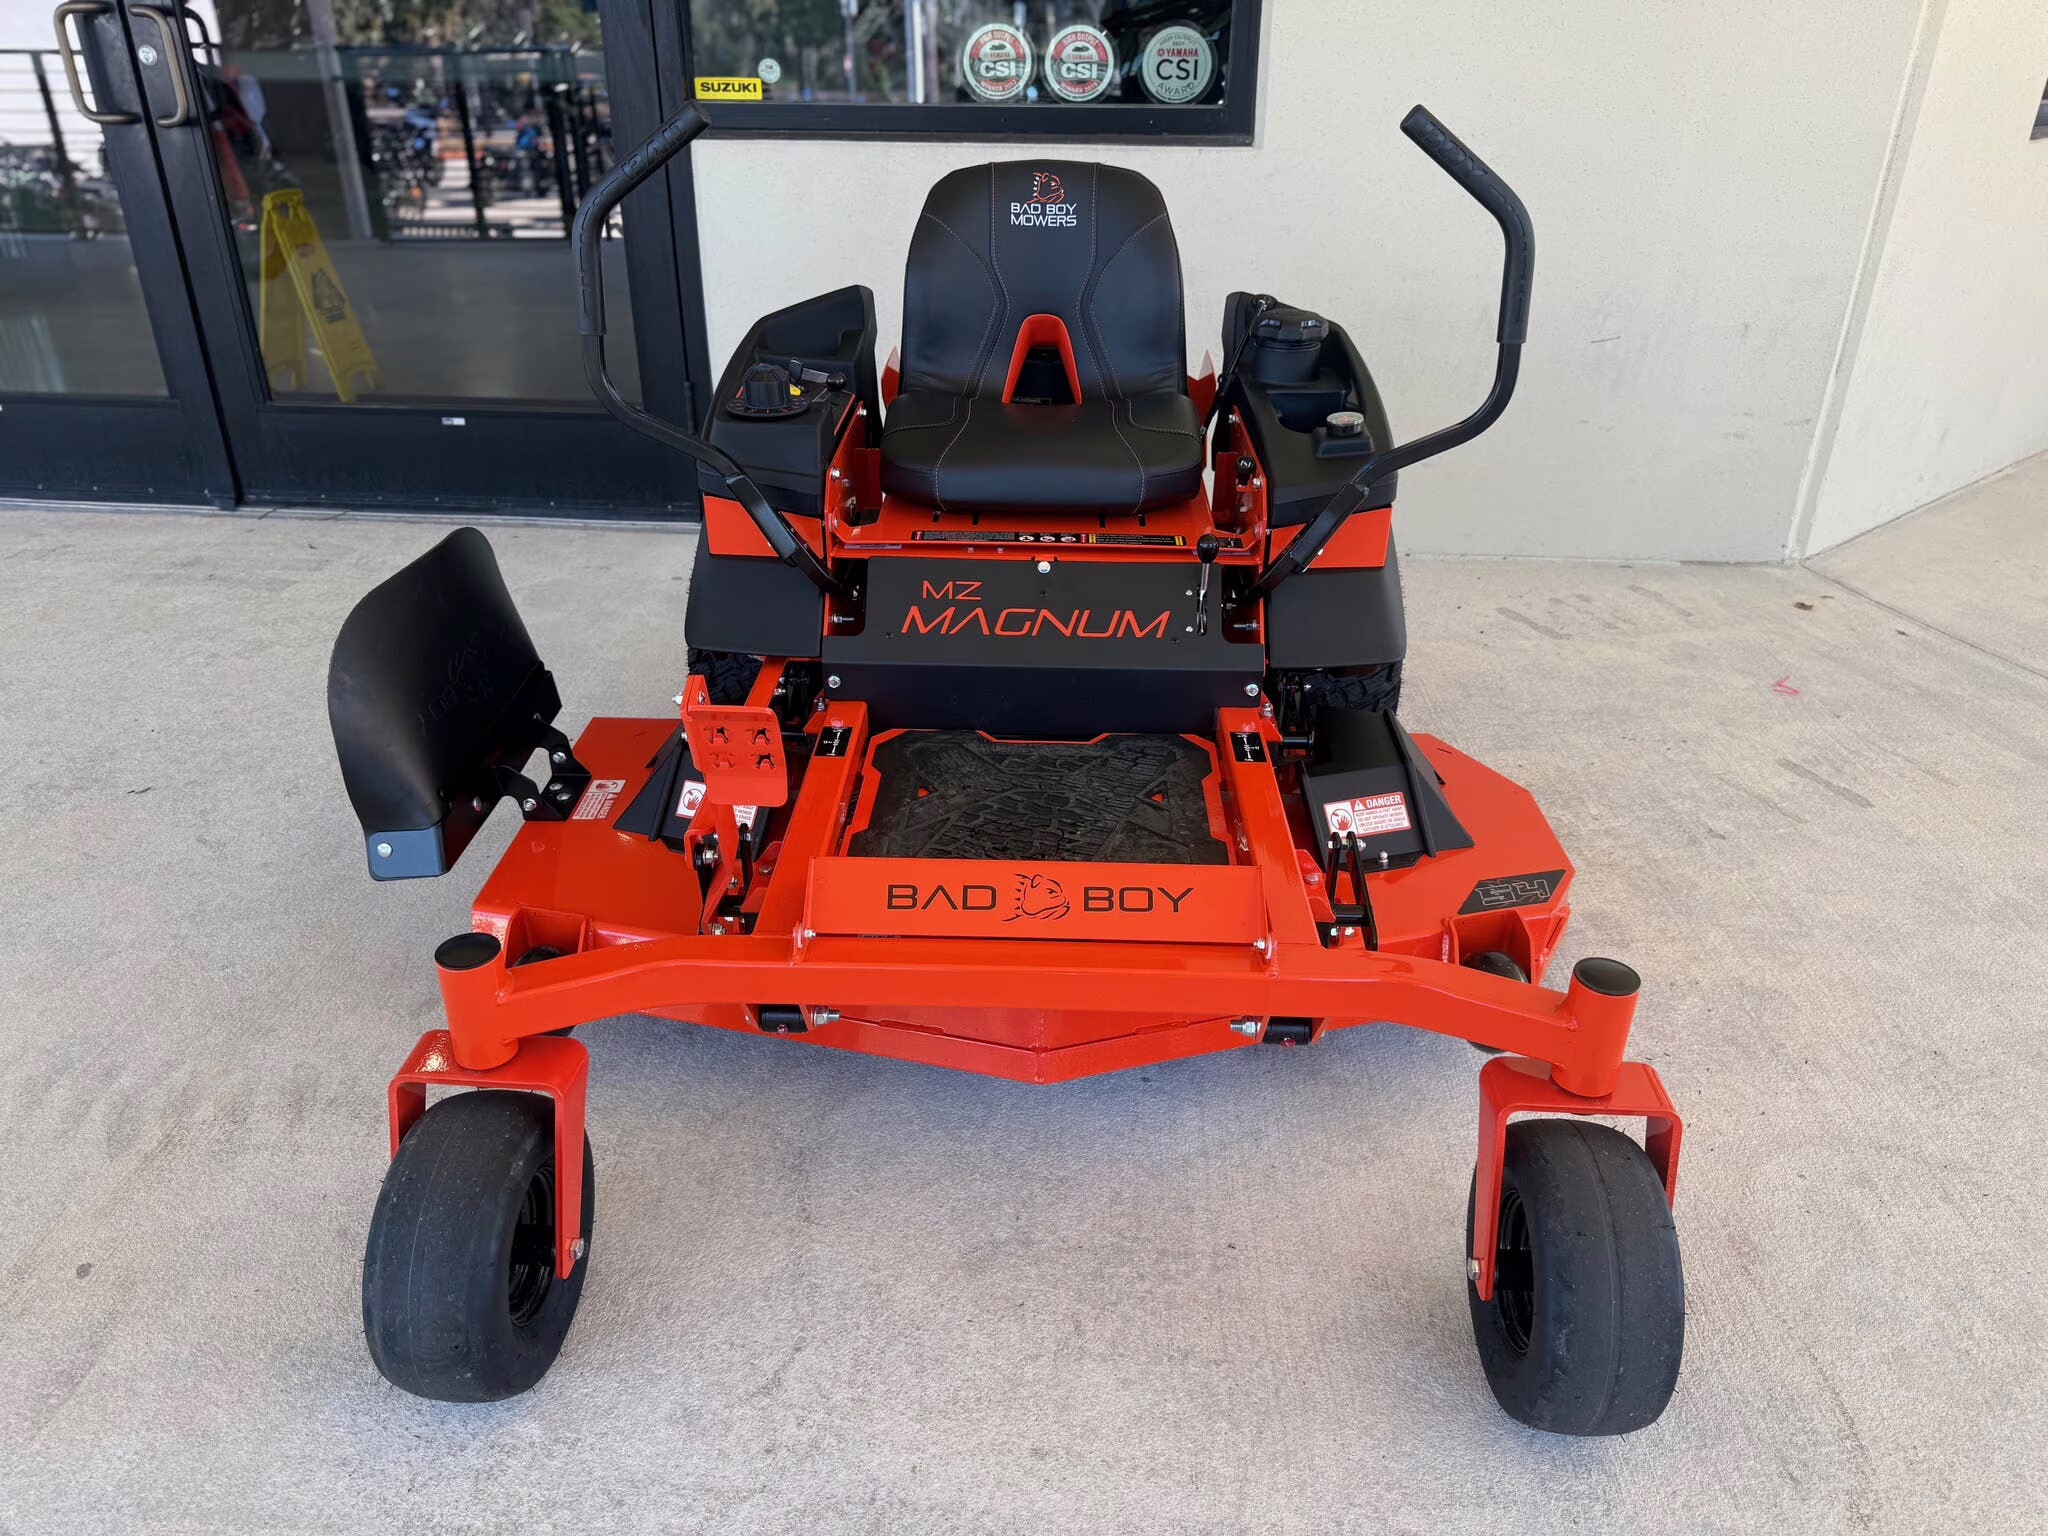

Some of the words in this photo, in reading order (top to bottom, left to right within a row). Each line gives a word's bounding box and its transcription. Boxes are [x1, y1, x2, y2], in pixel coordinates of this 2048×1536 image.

[1167, 48, 1199, 57] YAMAHA
[980, 61, 1016, 77] CSI
[1061, 63, 1098, 79] CSI
[1156, 59, 1198, 80] CSI
[700, 82, 757, 92] SUZUKI
[1158, 82, 1195, 95] AWARD
[1010, 202, 1041, 214] BAD
[1046, 203, 1077, 215] BOY
[1010, 214, 1077, 227] MOWERS
[922, 580, 983, 600] MZ
[901, 605, 1171, 639] MAGNUM
[1366, 796, 1402, 808] DANGER
[887, 884, 997, 911] BAD
[1083, 886, 1195, 913] BOY
[1475, 879, 1550, 905] 54
